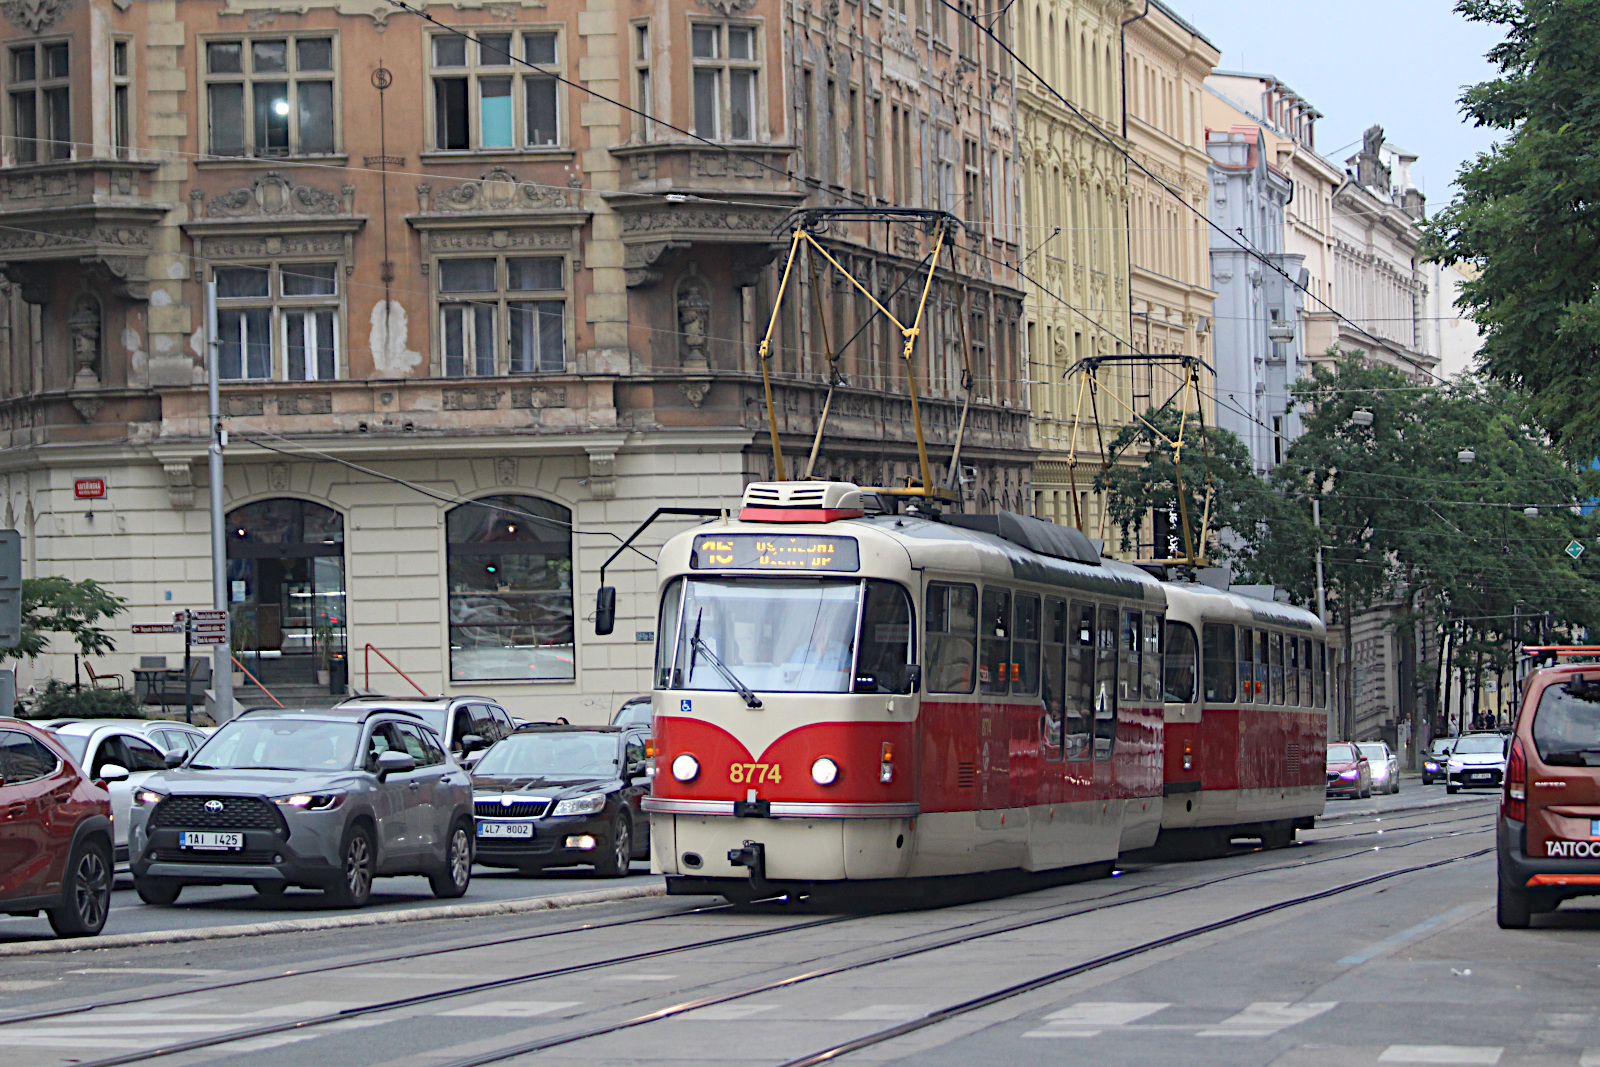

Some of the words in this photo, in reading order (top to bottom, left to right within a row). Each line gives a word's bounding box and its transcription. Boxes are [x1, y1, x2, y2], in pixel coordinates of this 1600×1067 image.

[730, 763, 782, 784] 8774
[485, 825, 500, 834] 4L7
[506, 825, 528, 834] 8002
